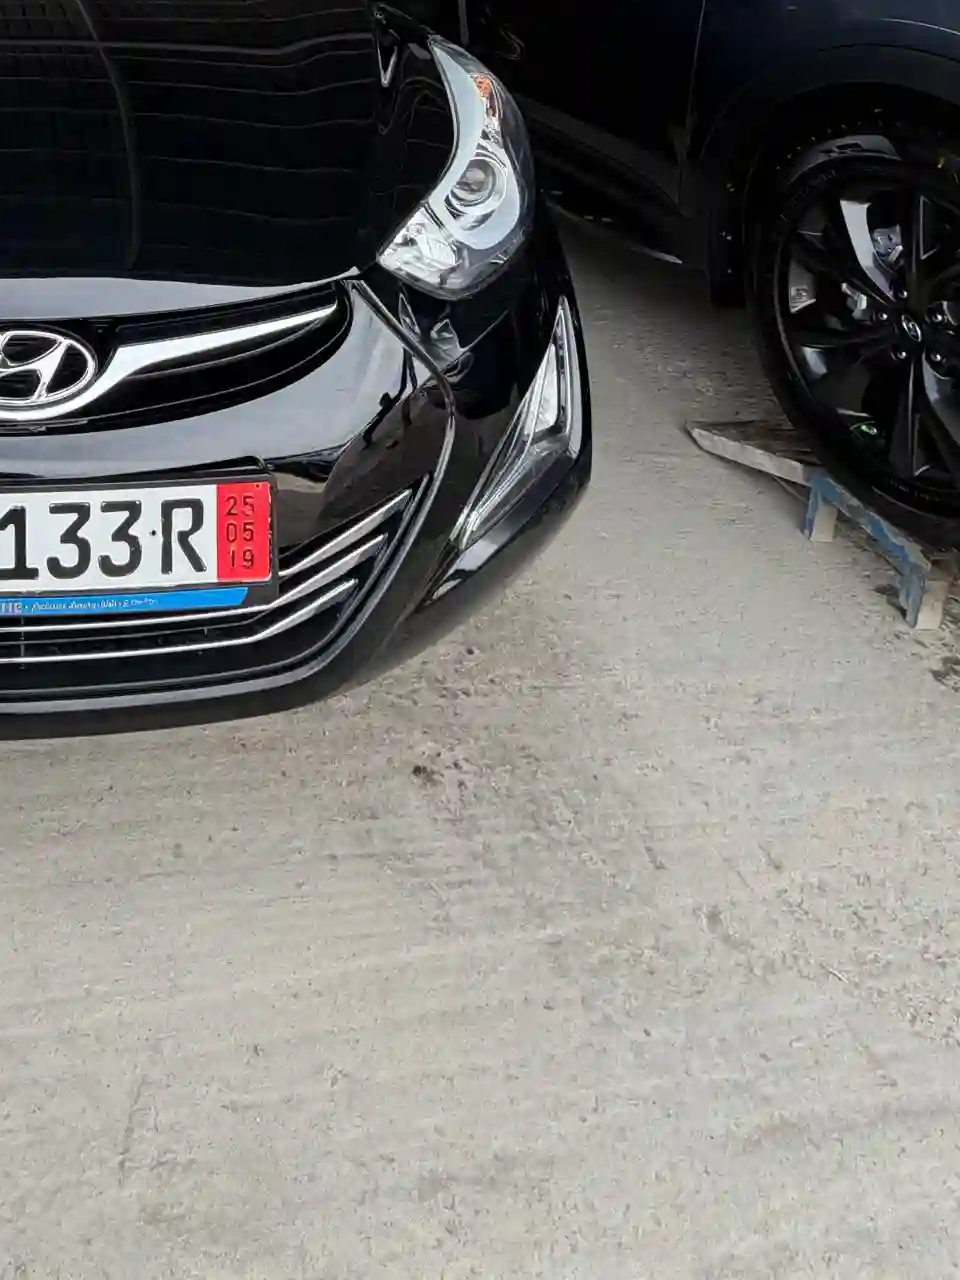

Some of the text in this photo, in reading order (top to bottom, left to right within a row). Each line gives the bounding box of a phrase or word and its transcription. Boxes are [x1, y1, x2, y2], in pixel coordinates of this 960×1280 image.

[225, 495, 255, 517] 25
[226, 521, 254, 543] 05
[228, 548, 254, 570] 19
